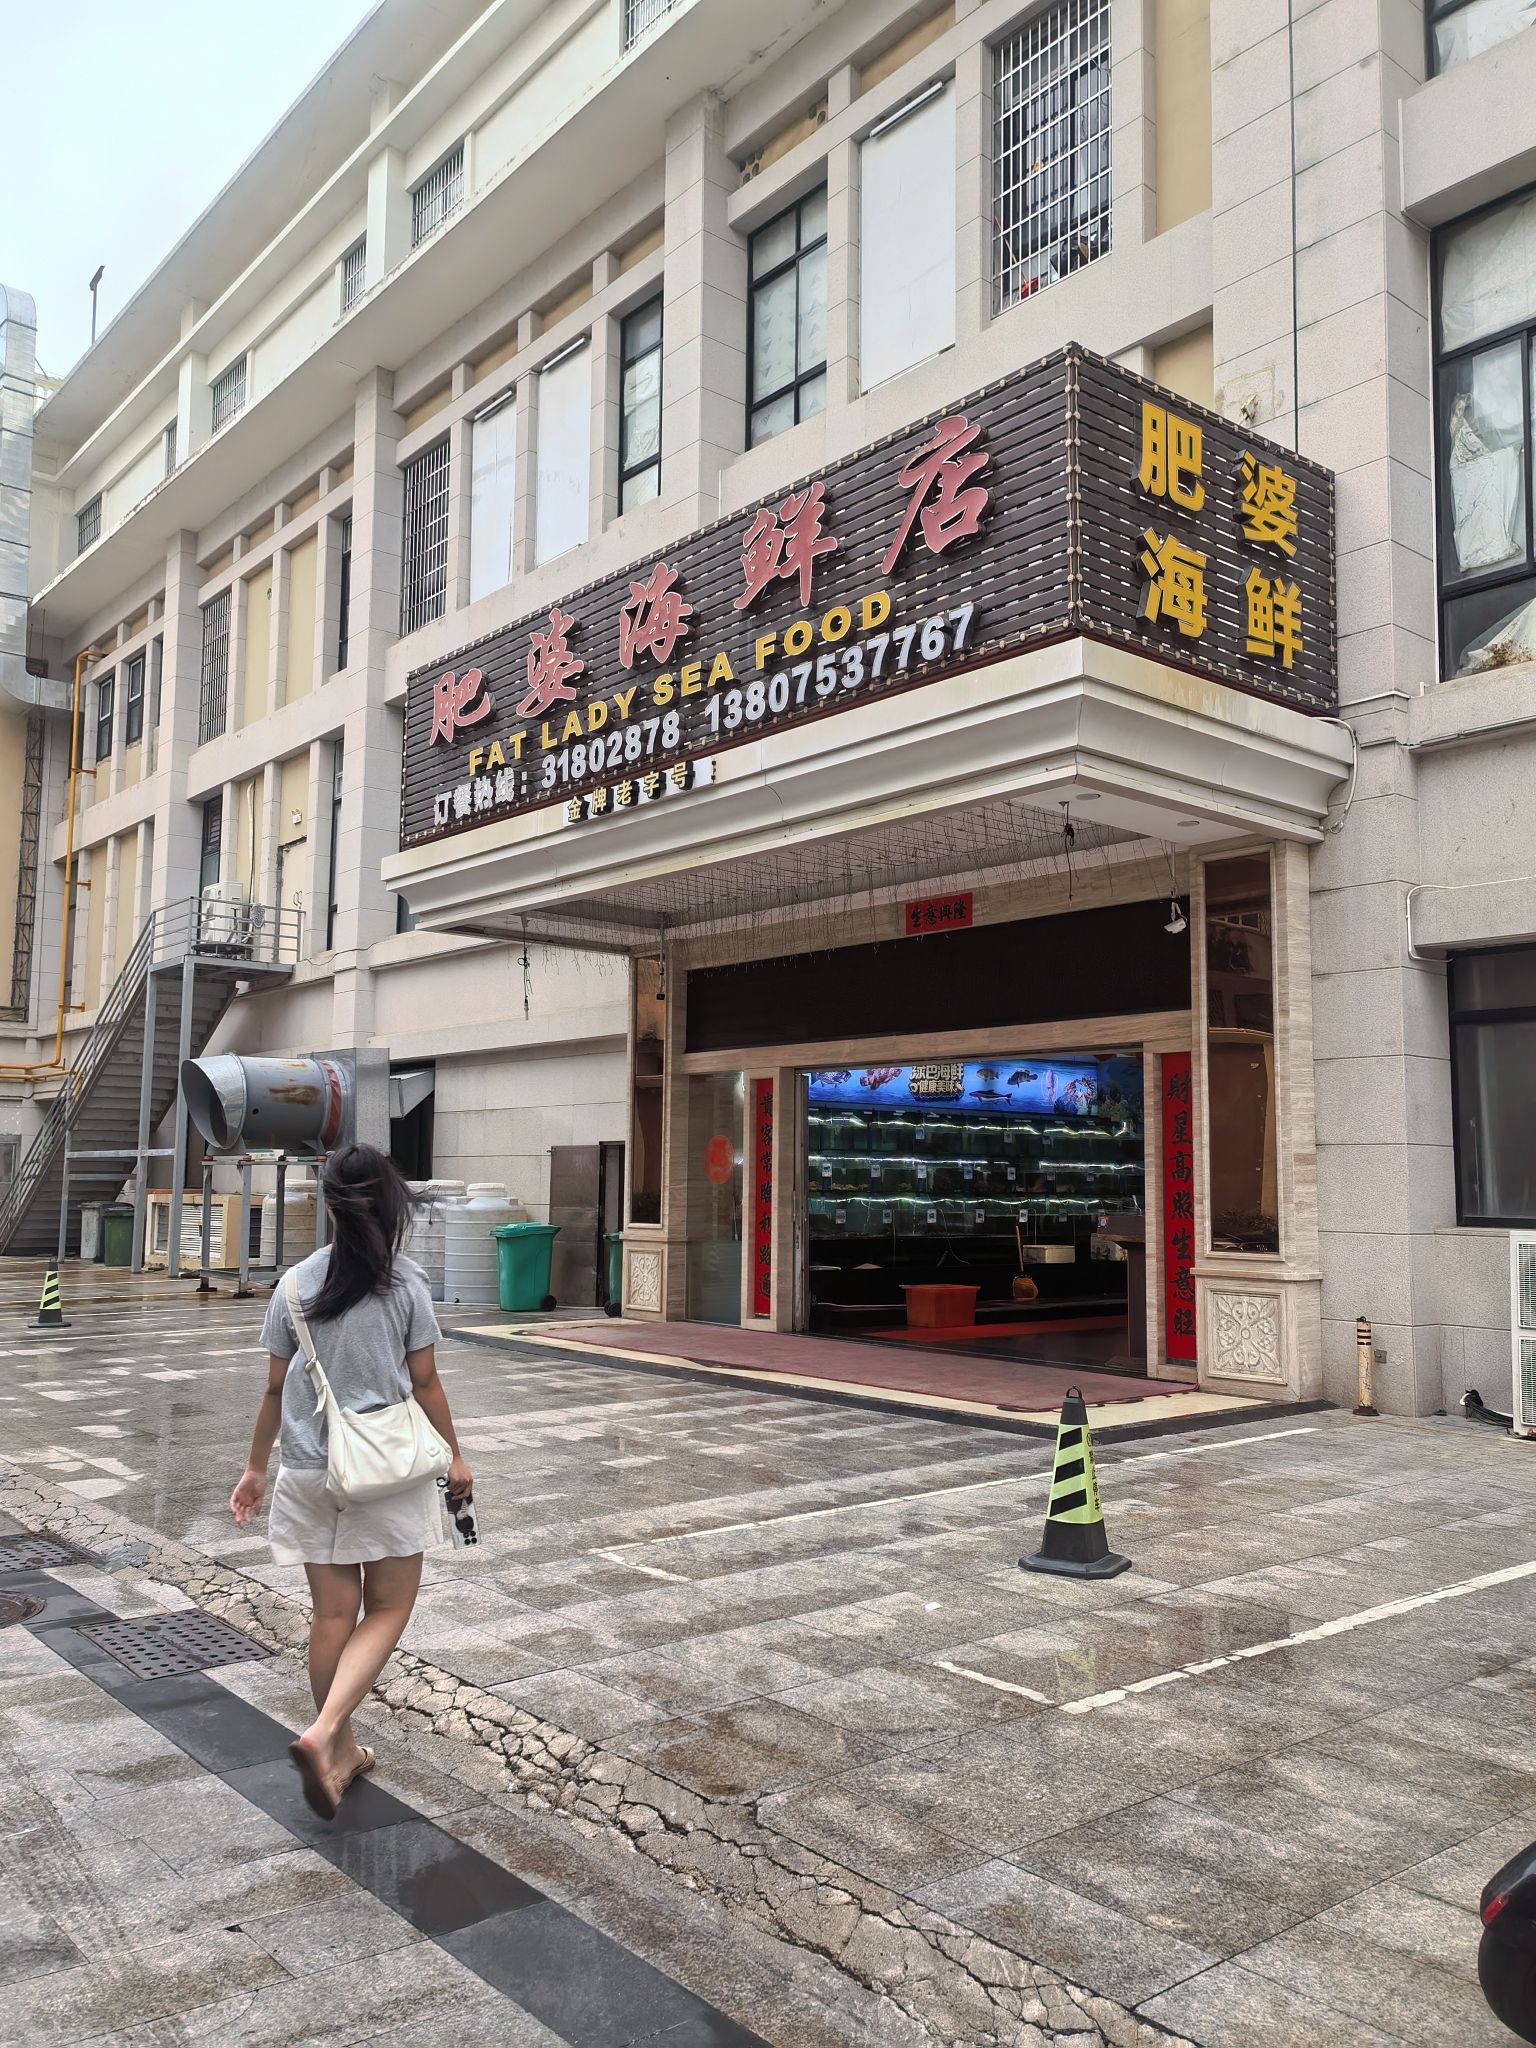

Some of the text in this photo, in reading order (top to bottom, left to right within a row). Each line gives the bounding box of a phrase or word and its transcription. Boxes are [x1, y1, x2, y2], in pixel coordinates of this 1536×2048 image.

[1140, 400, 1298, 557] 肥婆
[429, 415, 991, 746] 肥婆海鲜店
[1140, 527, 1304, 669] 海鲜
[468, 591, 892, 777] FAT LADY SEA FOOD
[541, 711, 680, 789] 31802878
[704, 604, 979, 733] 13807537767
[568, 762, 688, 821] 金牌老字号
